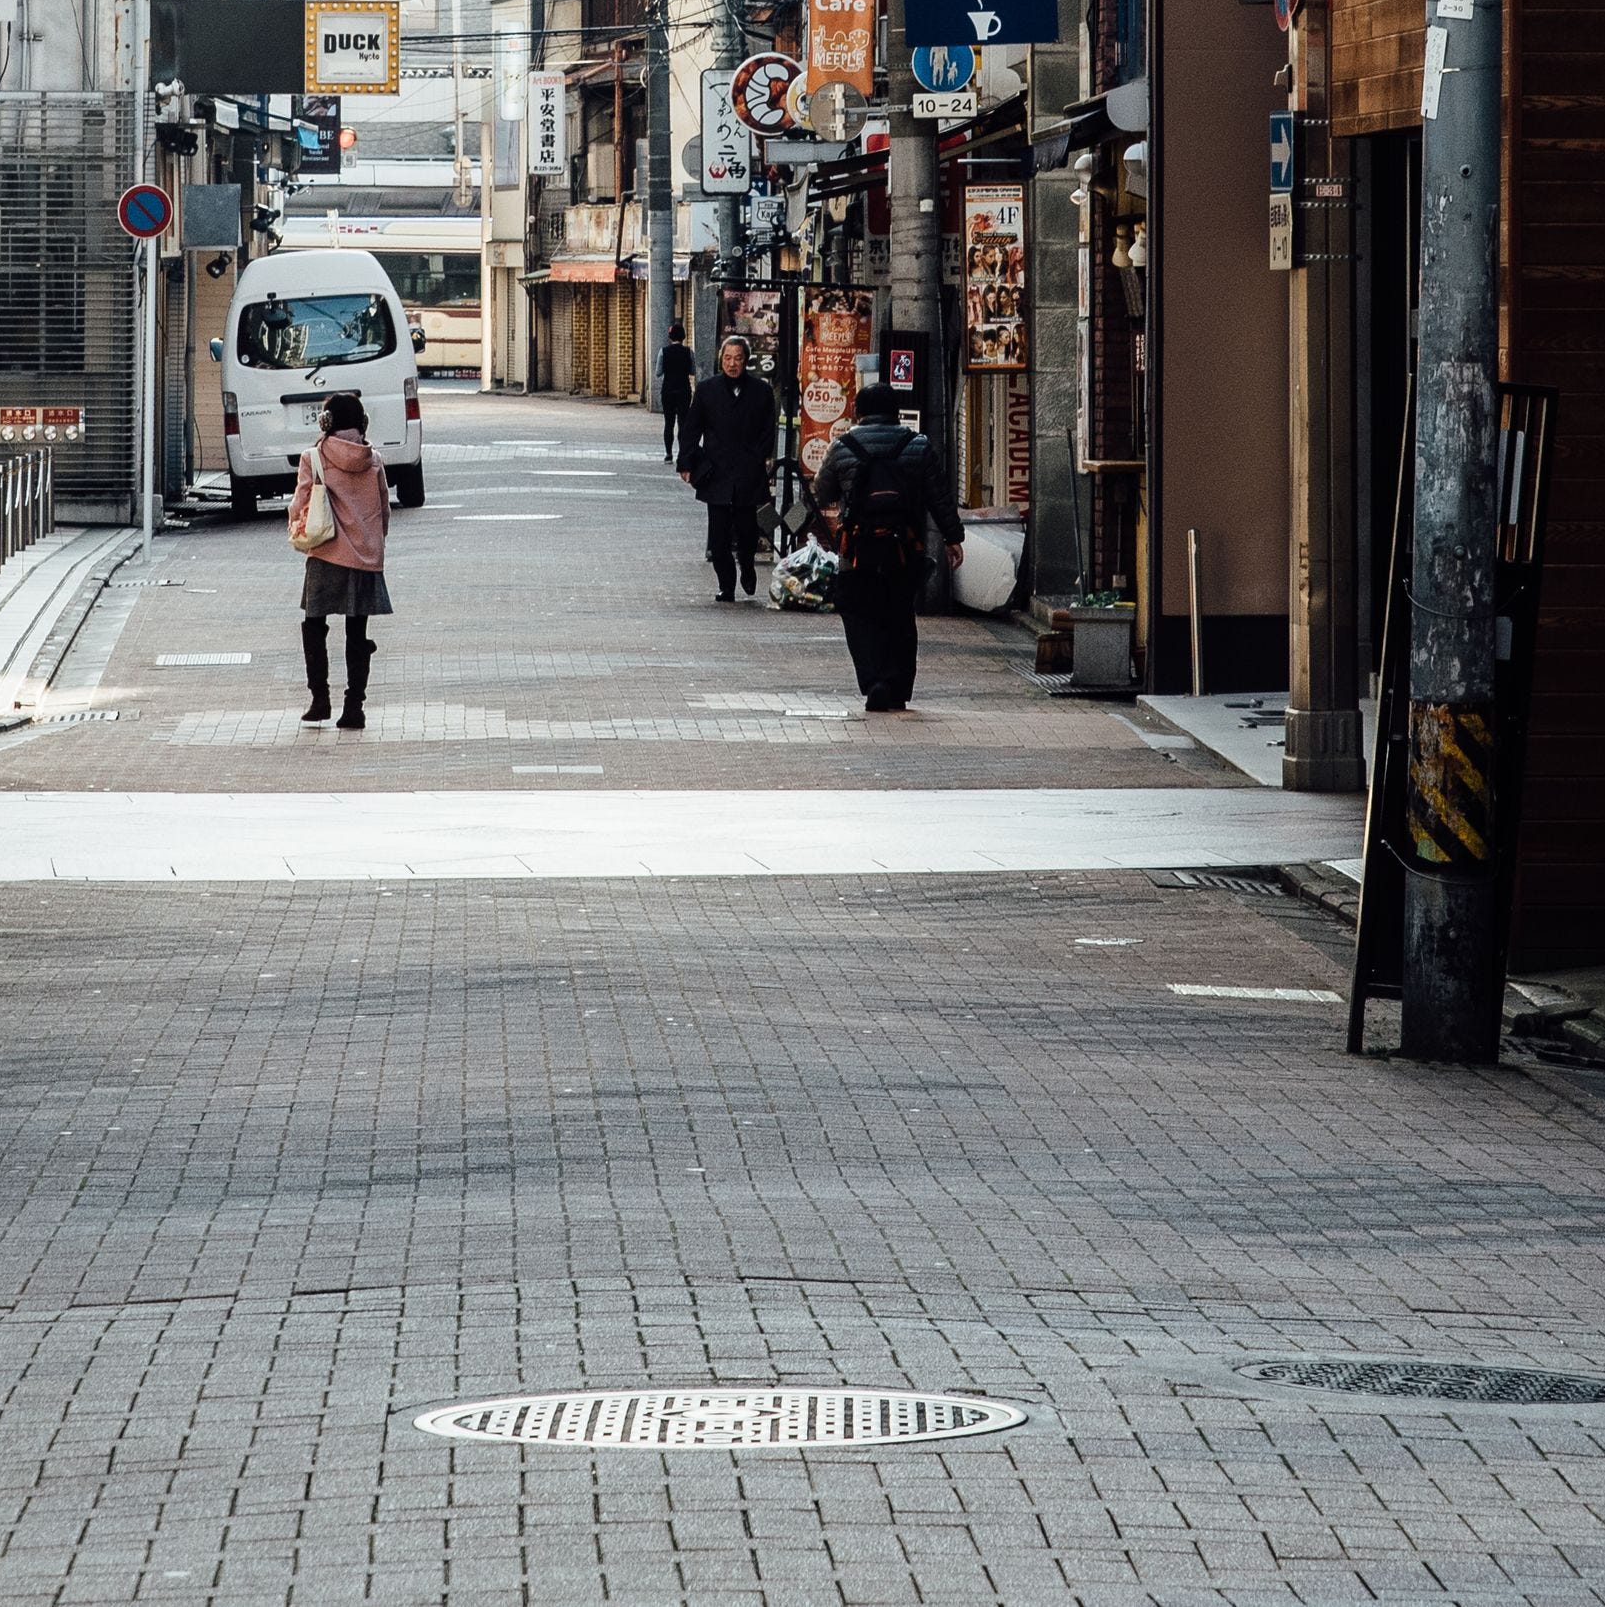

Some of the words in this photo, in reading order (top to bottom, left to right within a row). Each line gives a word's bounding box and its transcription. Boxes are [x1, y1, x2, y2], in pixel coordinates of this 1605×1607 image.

[324, 33, 381, 54] DUCK
[358, 53, 380, 63] Kyoto
[918, 98, 973, 113] 10-24
[539, 87, 556, 164] 平安堂書店
[996, 206, 1020, 225] 4F
[807, 390, 830, 402] 950
